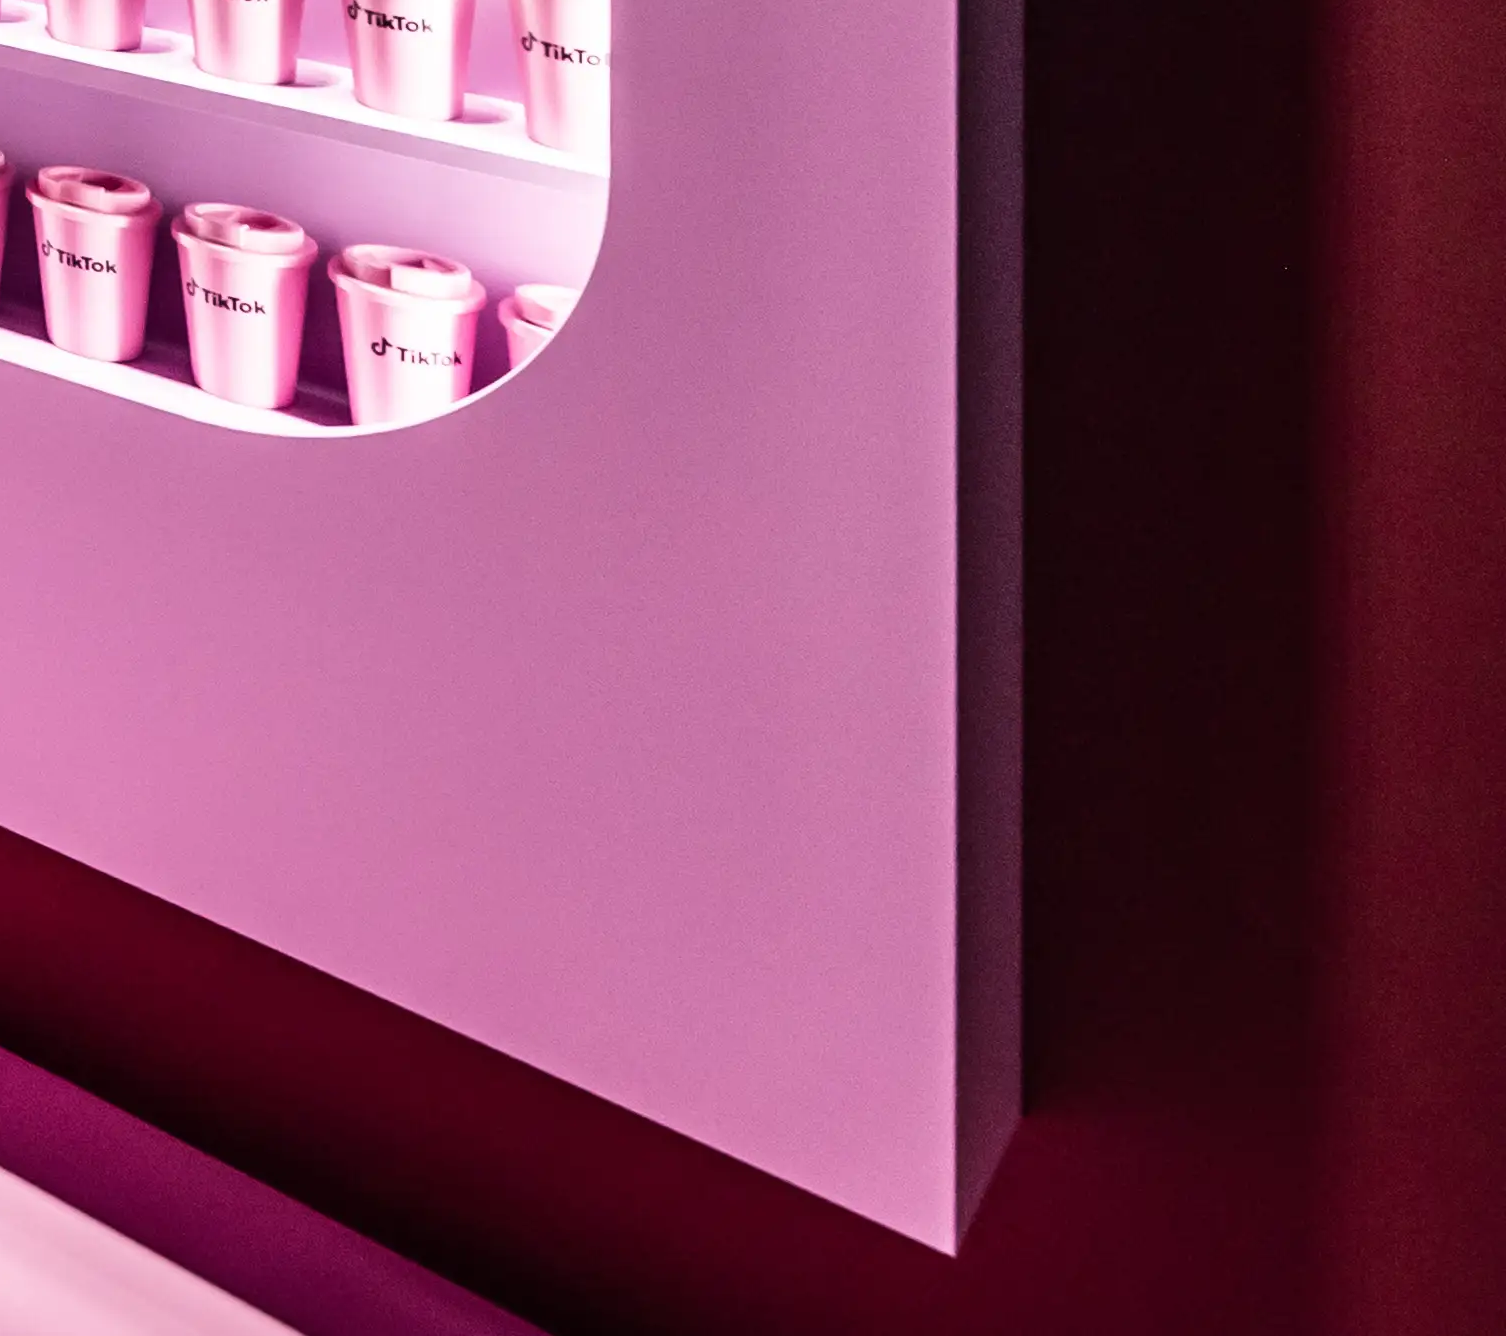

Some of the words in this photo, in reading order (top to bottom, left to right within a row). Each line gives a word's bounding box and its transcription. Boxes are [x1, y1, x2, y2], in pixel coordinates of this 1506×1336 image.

[364, 8, 433, 34] TikTok
[56, 248, 118, 275] TikTok
[202, 288, 267, 316] TikTok
[396, 347, 462, 366] TikTok
